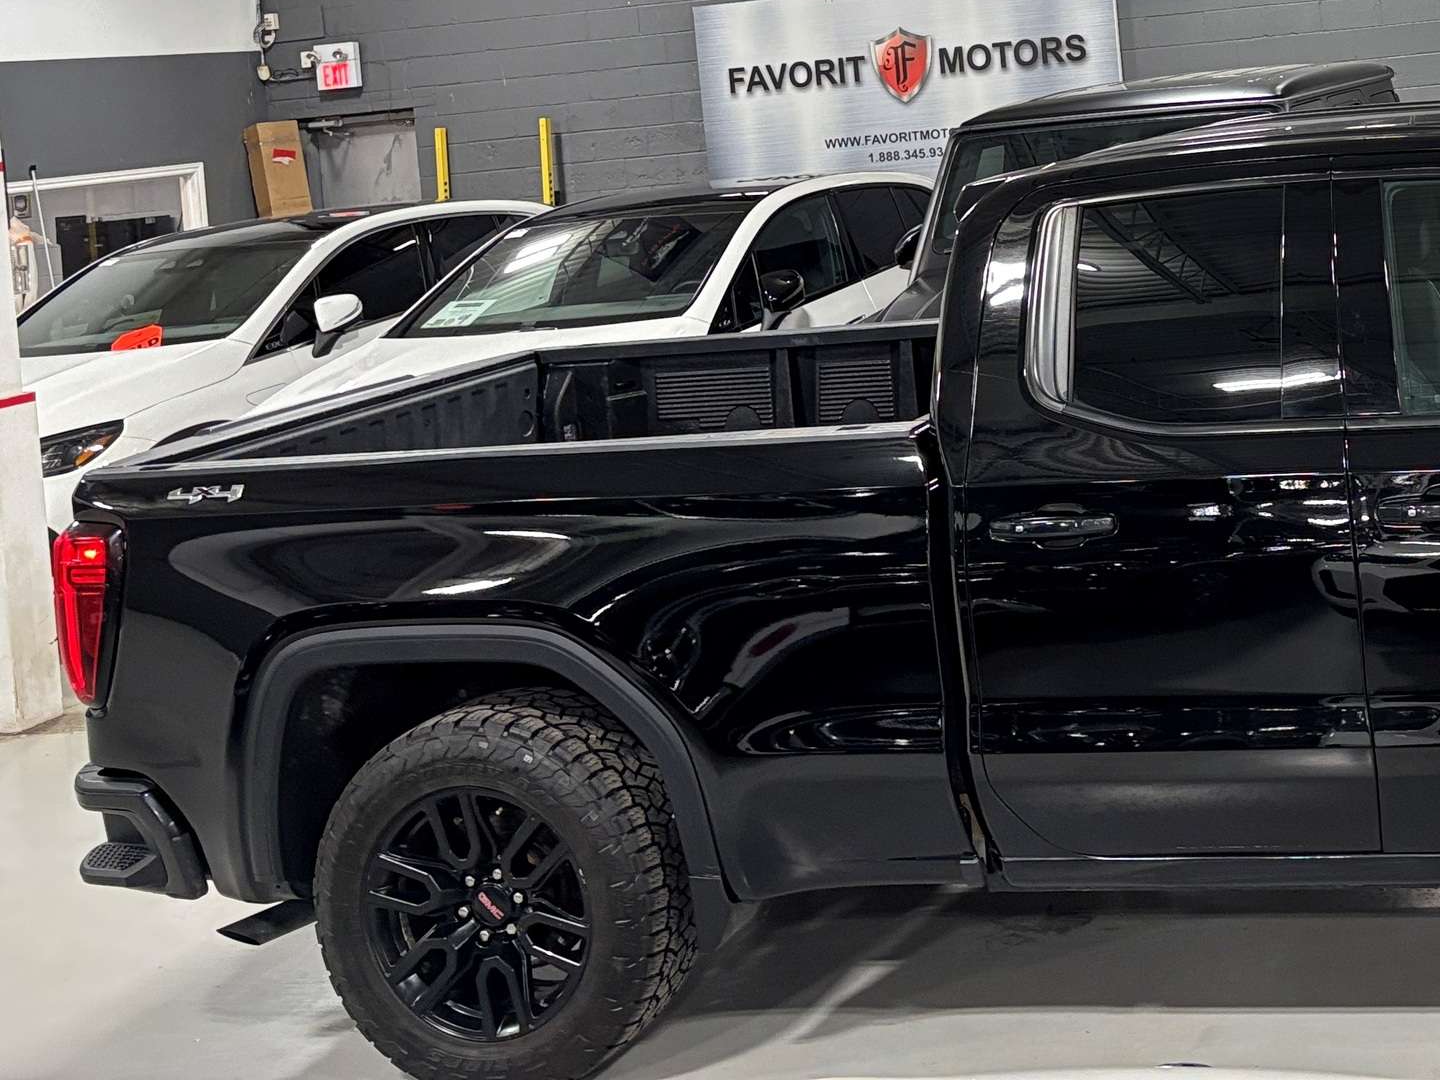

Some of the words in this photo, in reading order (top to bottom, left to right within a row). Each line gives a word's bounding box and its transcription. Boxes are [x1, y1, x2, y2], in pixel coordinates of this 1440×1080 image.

[322, 63, 349, 88] EXIT
[728, 55, 865, 95] FAVORIT
[939, 34, 1087, 75] MOTORS
[824, 126, 949, 150] WWW.FAVORITMOT
[868, 147, 944, 164] 1.888.345.93
[477, 891, 505, 921] GMC
